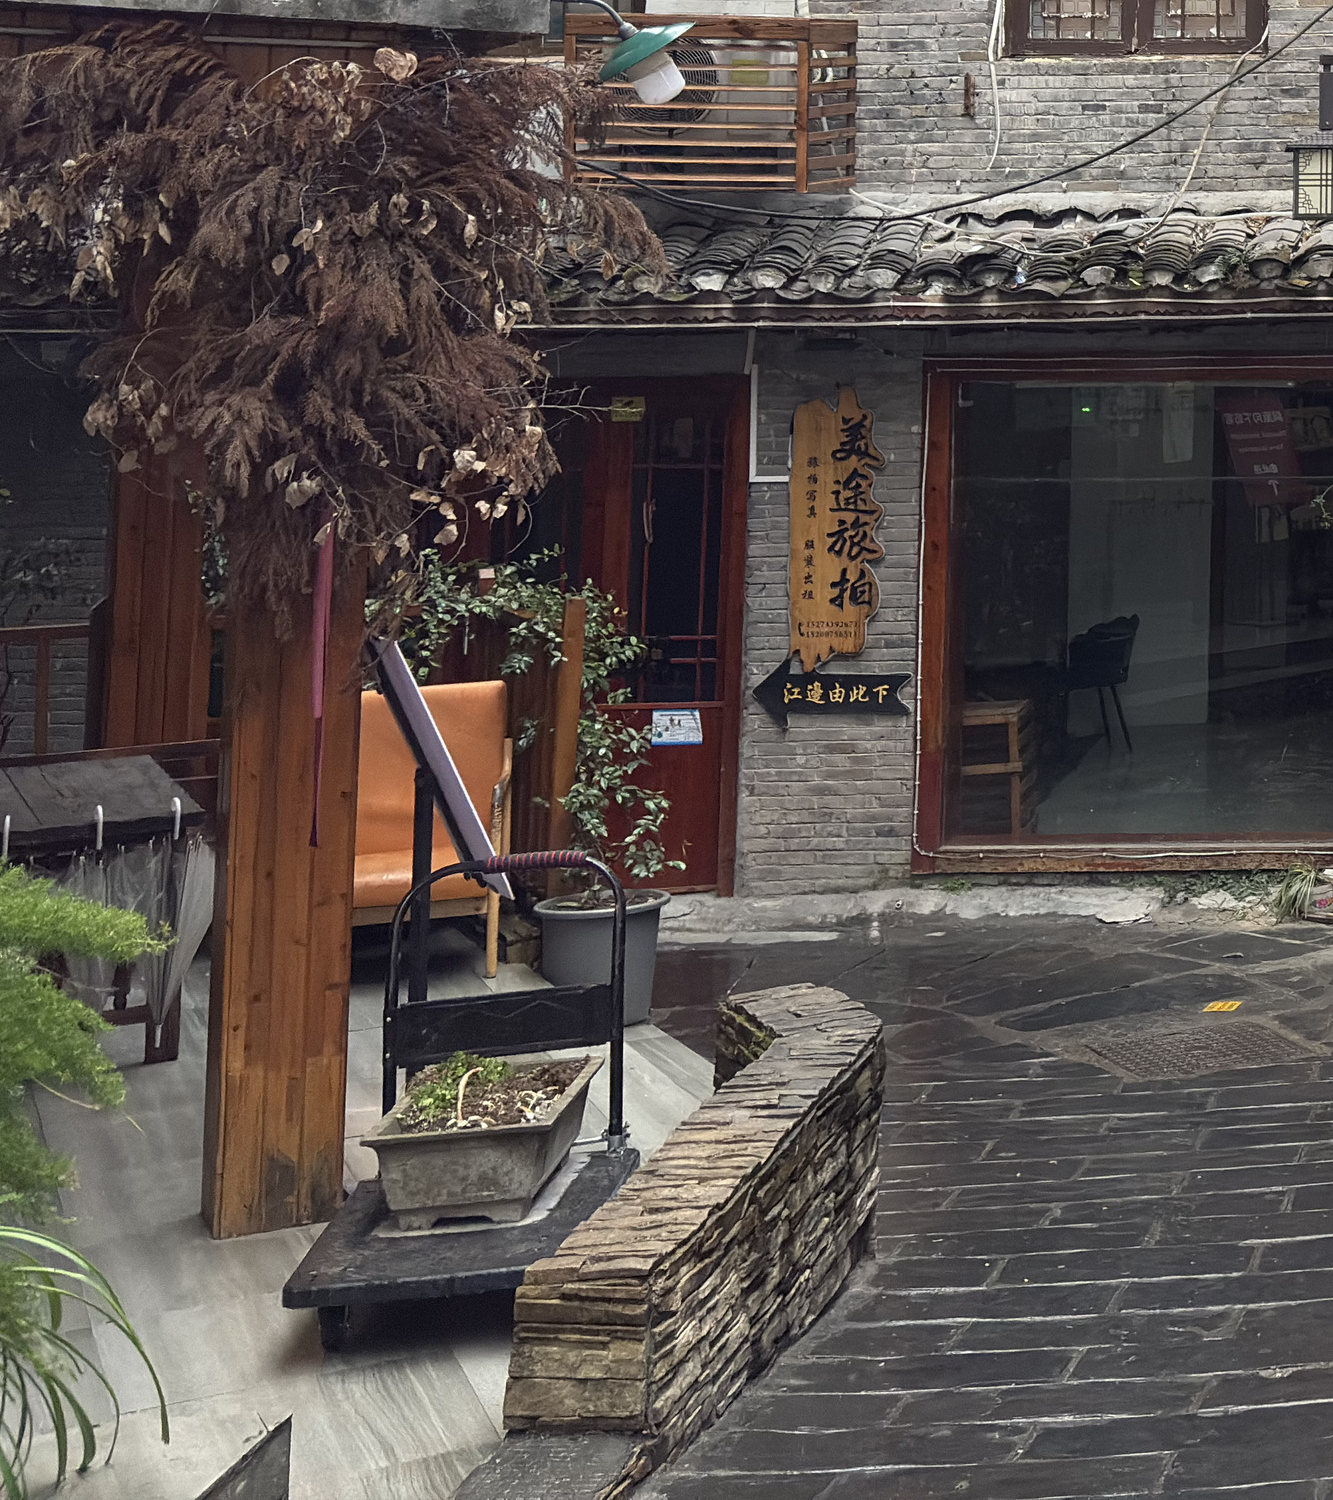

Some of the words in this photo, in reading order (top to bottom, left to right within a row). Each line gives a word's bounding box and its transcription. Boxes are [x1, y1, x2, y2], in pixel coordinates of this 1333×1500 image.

[827, 413, 881, 612] 美途旅拍
[783, 682, 890, 704] 江邊由此下
